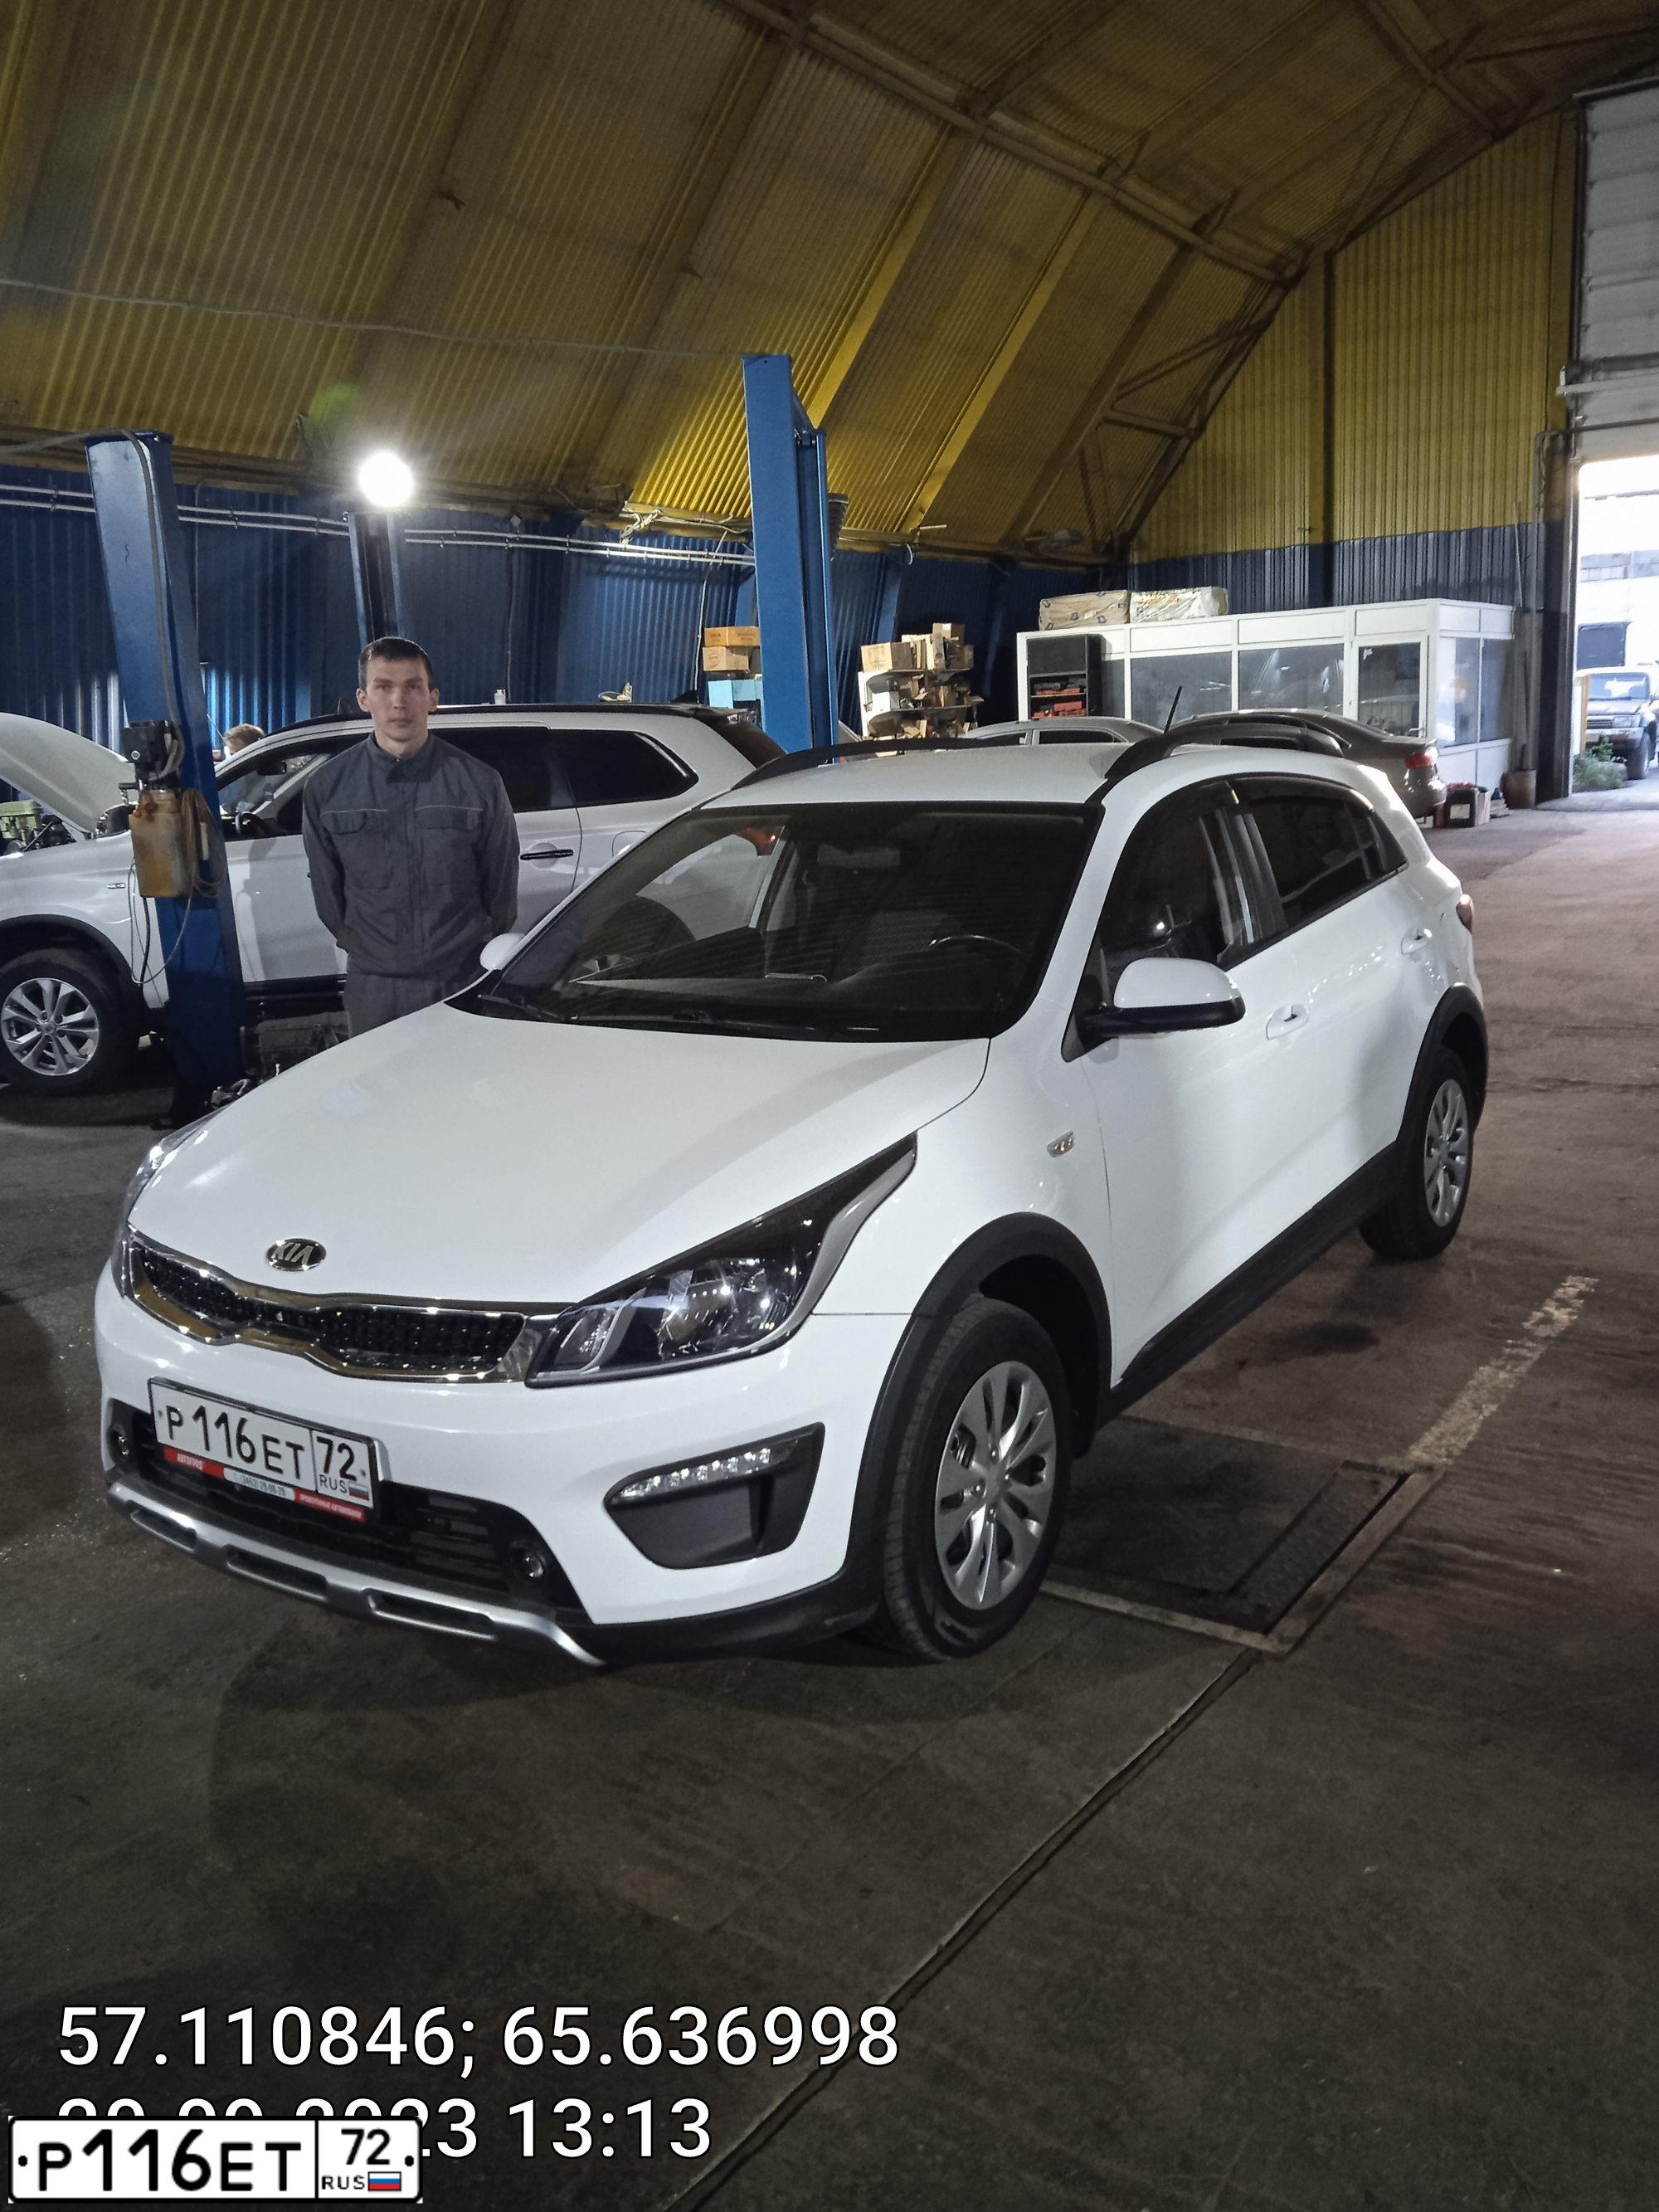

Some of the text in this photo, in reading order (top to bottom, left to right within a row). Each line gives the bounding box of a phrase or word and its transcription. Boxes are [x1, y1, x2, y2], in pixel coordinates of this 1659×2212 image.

[270, 1241, 315, 1267] KIA
[316, 1435, 358, 1482] 72
[319, 1474, 348, 1493] RUS
